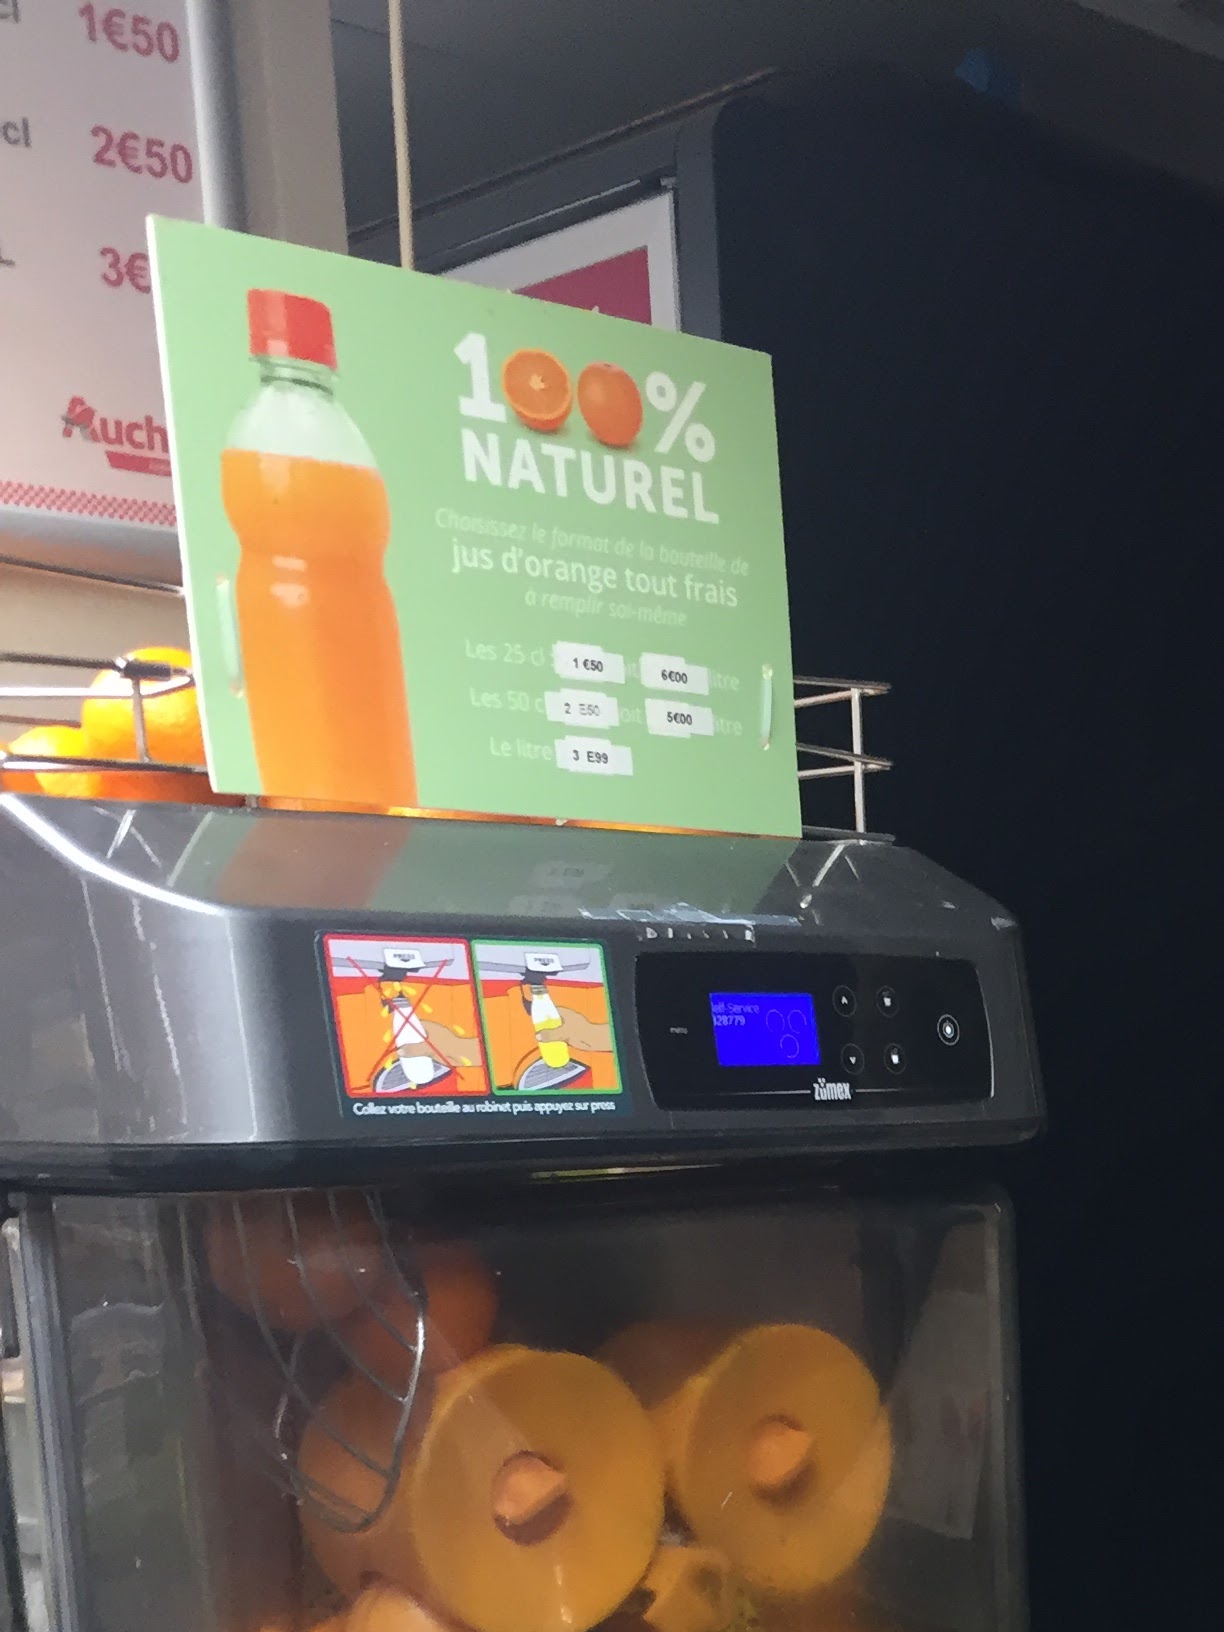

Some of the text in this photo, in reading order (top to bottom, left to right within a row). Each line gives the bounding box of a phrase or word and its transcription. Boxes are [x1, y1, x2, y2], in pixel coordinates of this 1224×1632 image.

[78, 2, 180, 63] 1€50
[90, 124, 193, 184] 2€50
[460, 428, 719, 524] NATUREL
[451, 538, 738, 607] jus d'orange tout frais
[531, 522, 546, 543] le
[614, 538, 634, 558] de
[731, 556, 749, 576] de
[465, 639, 497, 661] Les
[503, 643, 525, 664] 25
[661, 669, 688, 685] 6€00
[469, 687, 501, 709] Les
[507, 690, 529, 711] 50
[666, 711, 692, 726] 5€00
[490, 737, 511, 757] Le
[516, 738, 551, 760] litre
[352, 1101, 616, 1116] Collez votre bouteille au robinet puis appuyez sur press
